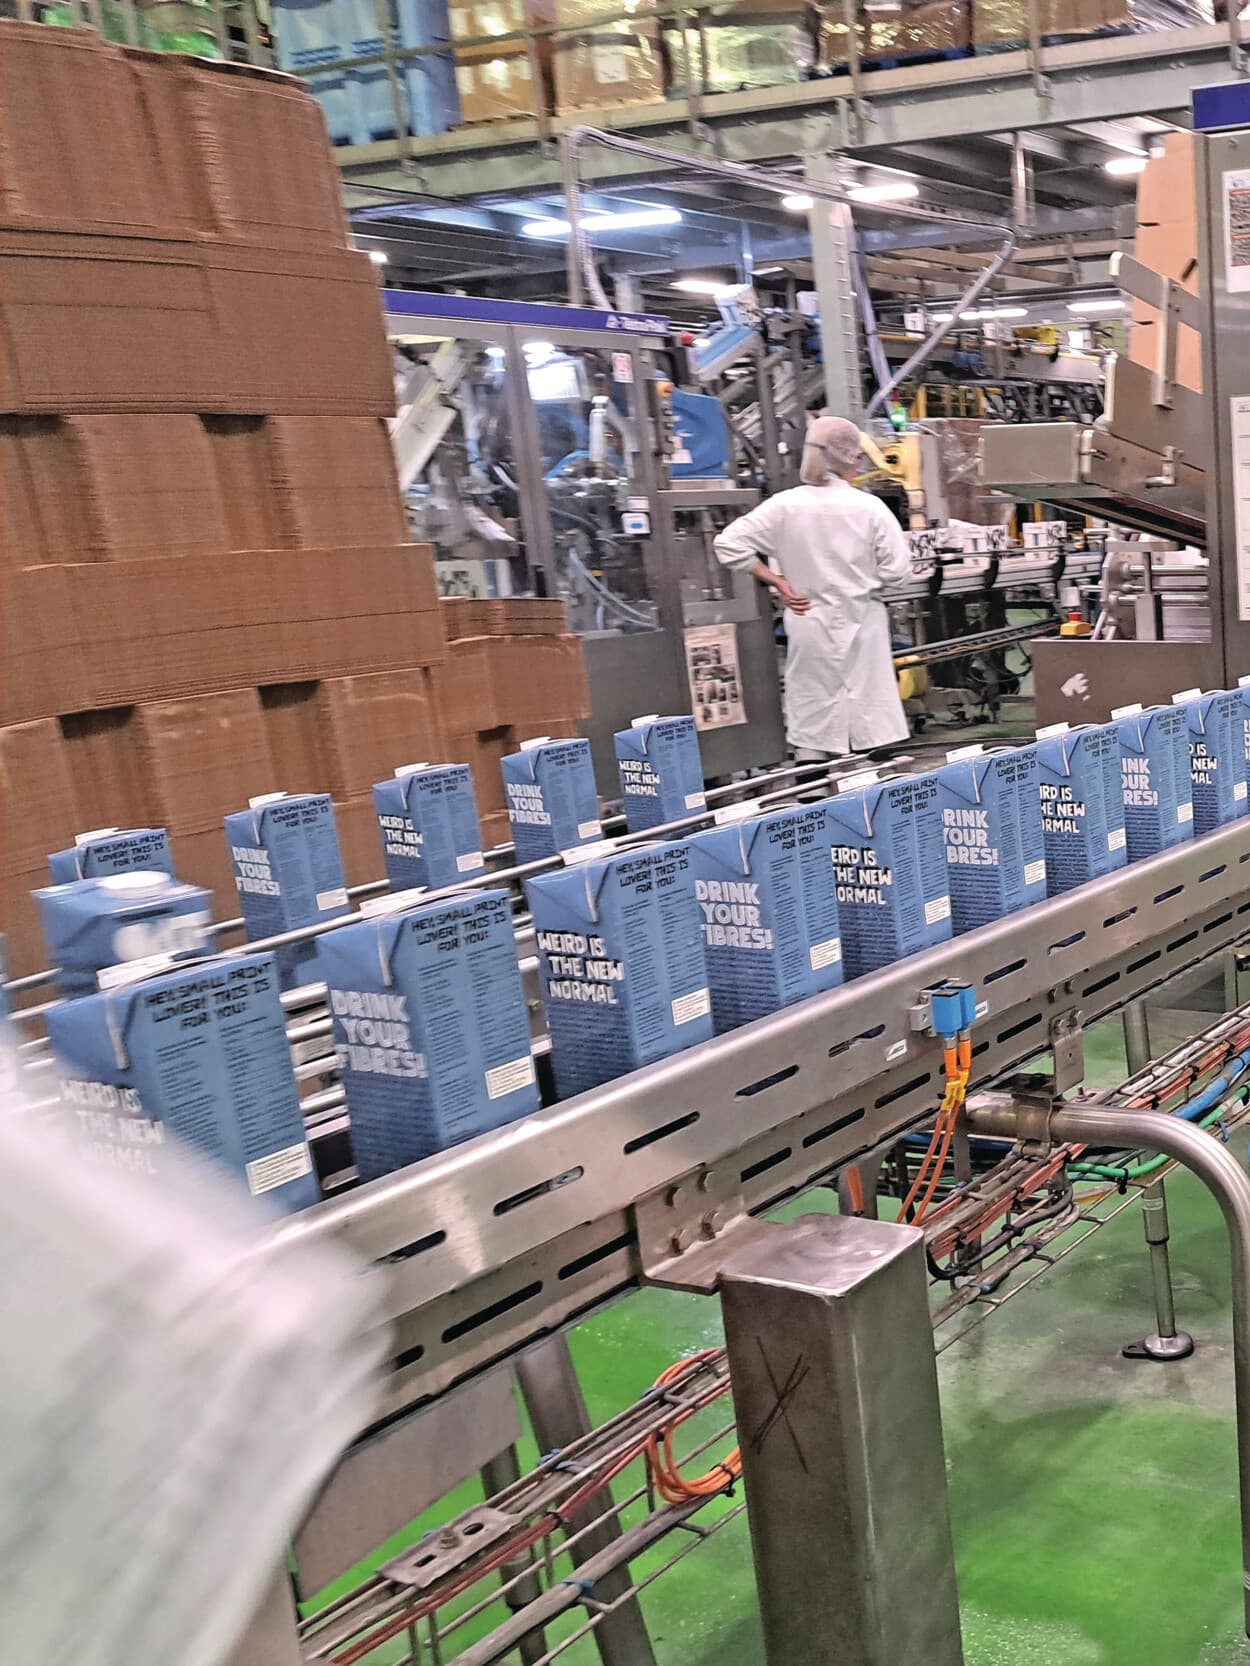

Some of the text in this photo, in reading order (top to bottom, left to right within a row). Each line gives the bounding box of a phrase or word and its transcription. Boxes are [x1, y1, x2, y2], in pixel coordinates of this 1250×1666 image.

[1197, 743, 1207, 756] IS
[643, 762, 652, 772] IS
[1121, 757, 1151, 774] INK
[1193, 757, 1217, 770] NEW
[624, 772, 660, 785] THE NEW
[1191, 772, 1212, 784] MAL
[507, 784, 543, 799] DRINK
[625, 784, 658, 796] NORMAL
[1039, 785, 1072, 801] IRD IS
[1123, 789, 1158, 806] RES!
[511, 798, 544, 811] YOUR
[1041, 802, 1085, 817] HE NEW
[405, 819, 414, 830] IS
[942, 808, 989, 828] RINK
[1042, 818, 1080, 833] RMAL
[385, 829, 423, 844] THE NEW
[232, 846, 270, 864] DRINK
[831, 847, 877, 866] EIRD IS
[946, 845, 999, 866] BRES!
[237, 862, 272, 880] YOUR
[858, 869, 892, 885] NEW
[695, 880, 760, 905] DRINK
[835, 886, 887, 905] ORMAL
[699, 903, 761, 927] YOUR
[537, 932, 608, 957] WEIRD IS
[548, 955, 624, 981] THE NEW
[549, 980, 619, 1005] NORMAL
[331, 990, 411, 1022] DRINK
[339, 1018, 412, 1050] YOUR
